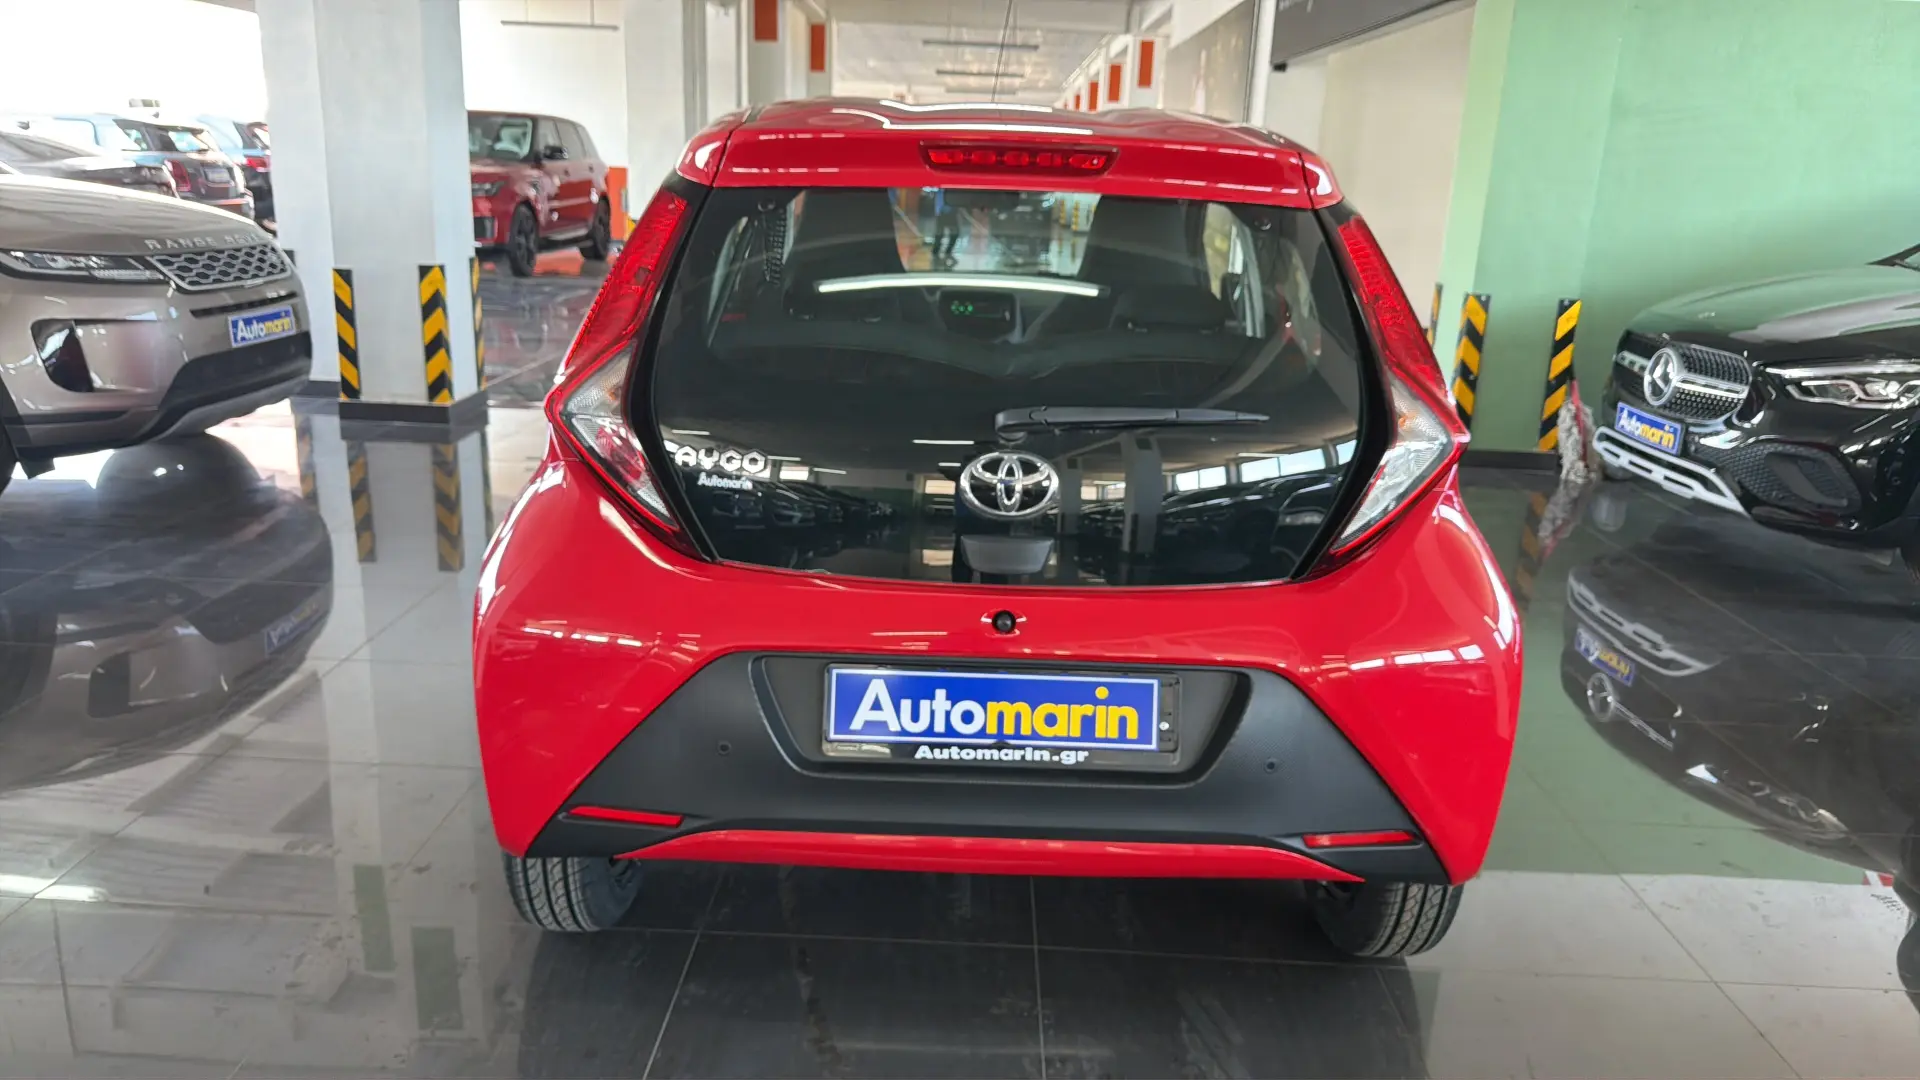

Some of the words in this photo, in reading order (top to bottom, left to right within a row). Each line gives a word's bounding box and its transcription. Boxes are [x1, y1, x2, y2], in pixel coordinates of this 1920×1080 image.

[145, 236, 217, 250] RANGE
[236, 311, 291, 341] Automarin
[1619, 407, 1675, 449] Automarin
[674, 445, 766, 474] AYGO
[698, 471, 753, 490] Automarin
[849, 678, 1138, 739] Automarin
[914, 745, 1089, 764] Automarin.gr
